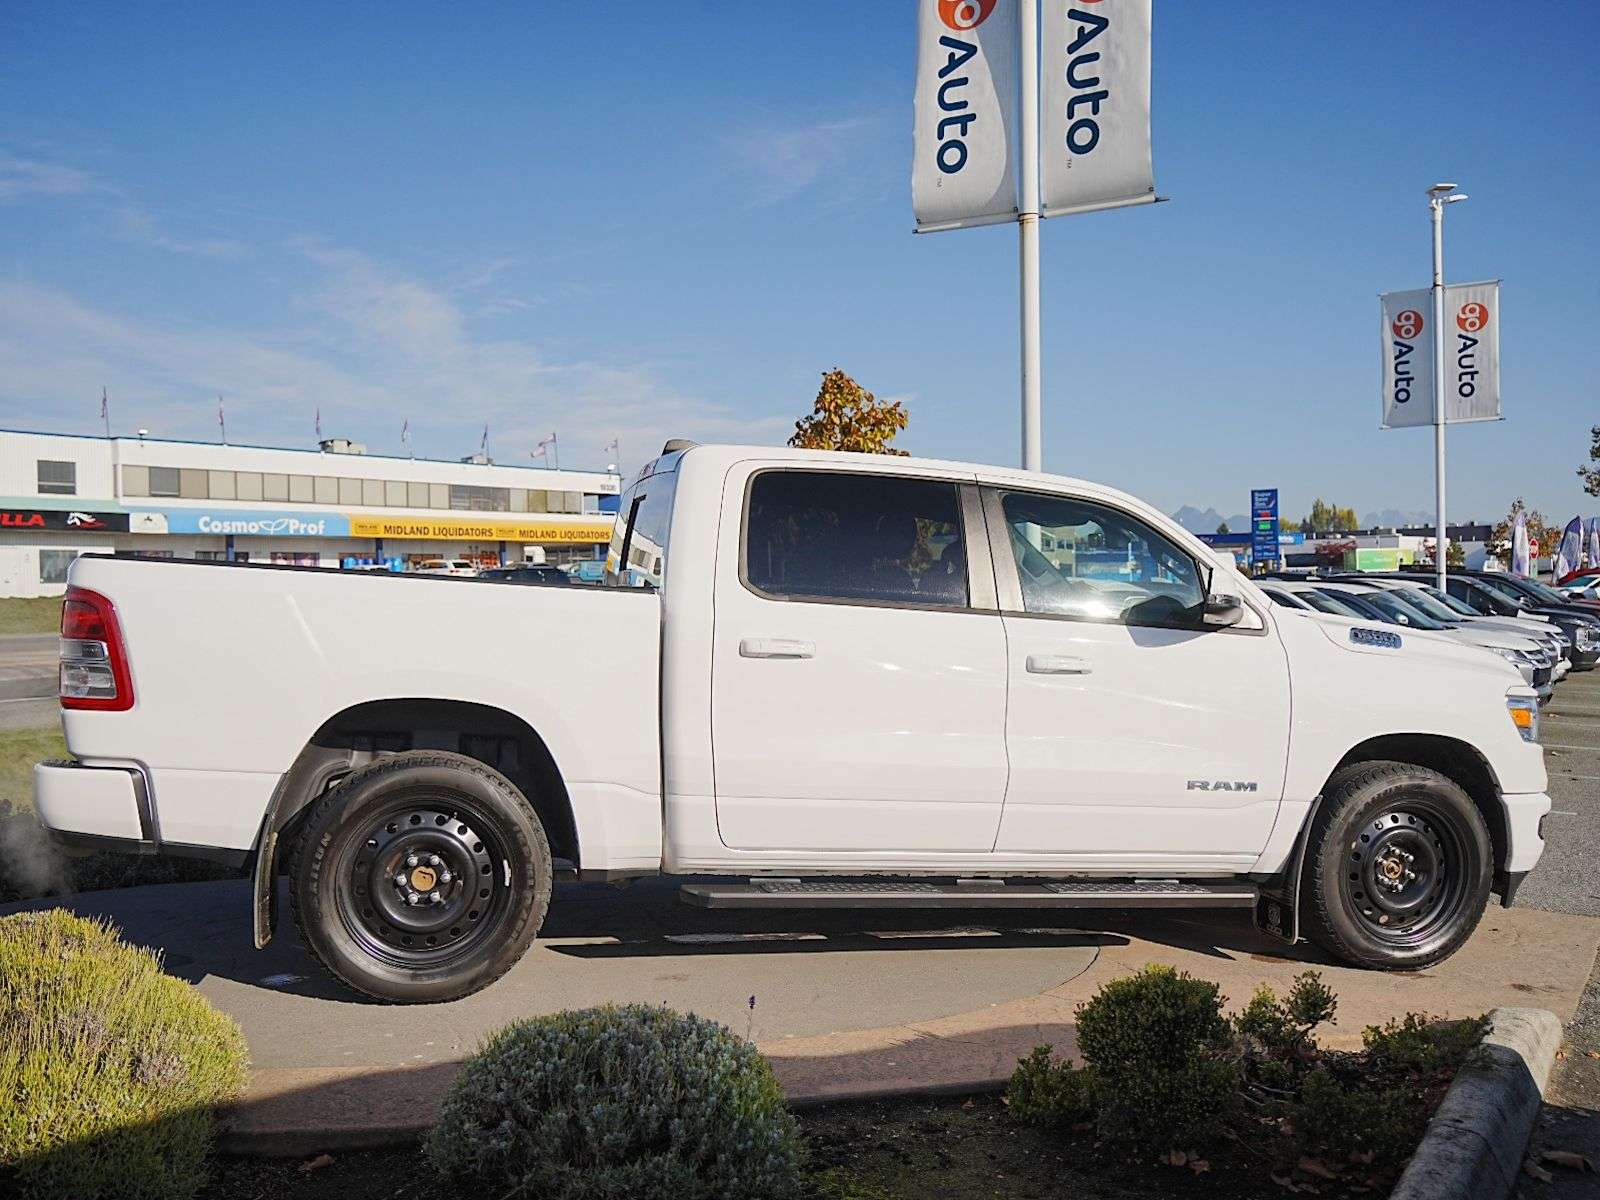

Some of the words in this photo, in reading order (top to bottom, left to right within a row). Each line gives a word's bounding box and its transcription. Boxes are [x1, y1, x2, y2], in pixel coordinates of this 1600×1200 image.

[1066, 8, 1110, 155] Auto
[936, 35, 978, 175] Auto
[1393, 340, 1415, 403] Auto
[1457, 333, 1480, 398] Auto
[198, 516, 260, 534] Cosmo
[288, 518, 326, 535] Prof
[383, 525, 430, 536] MIDLAND
[433, 527, 494, 537] LIQUIDATORS
[519, 529, 557, 539] MIDLAND
[560, 530, 610, 540] LIQUIDATORS
[1186, 780, 1258, 792] RAM
